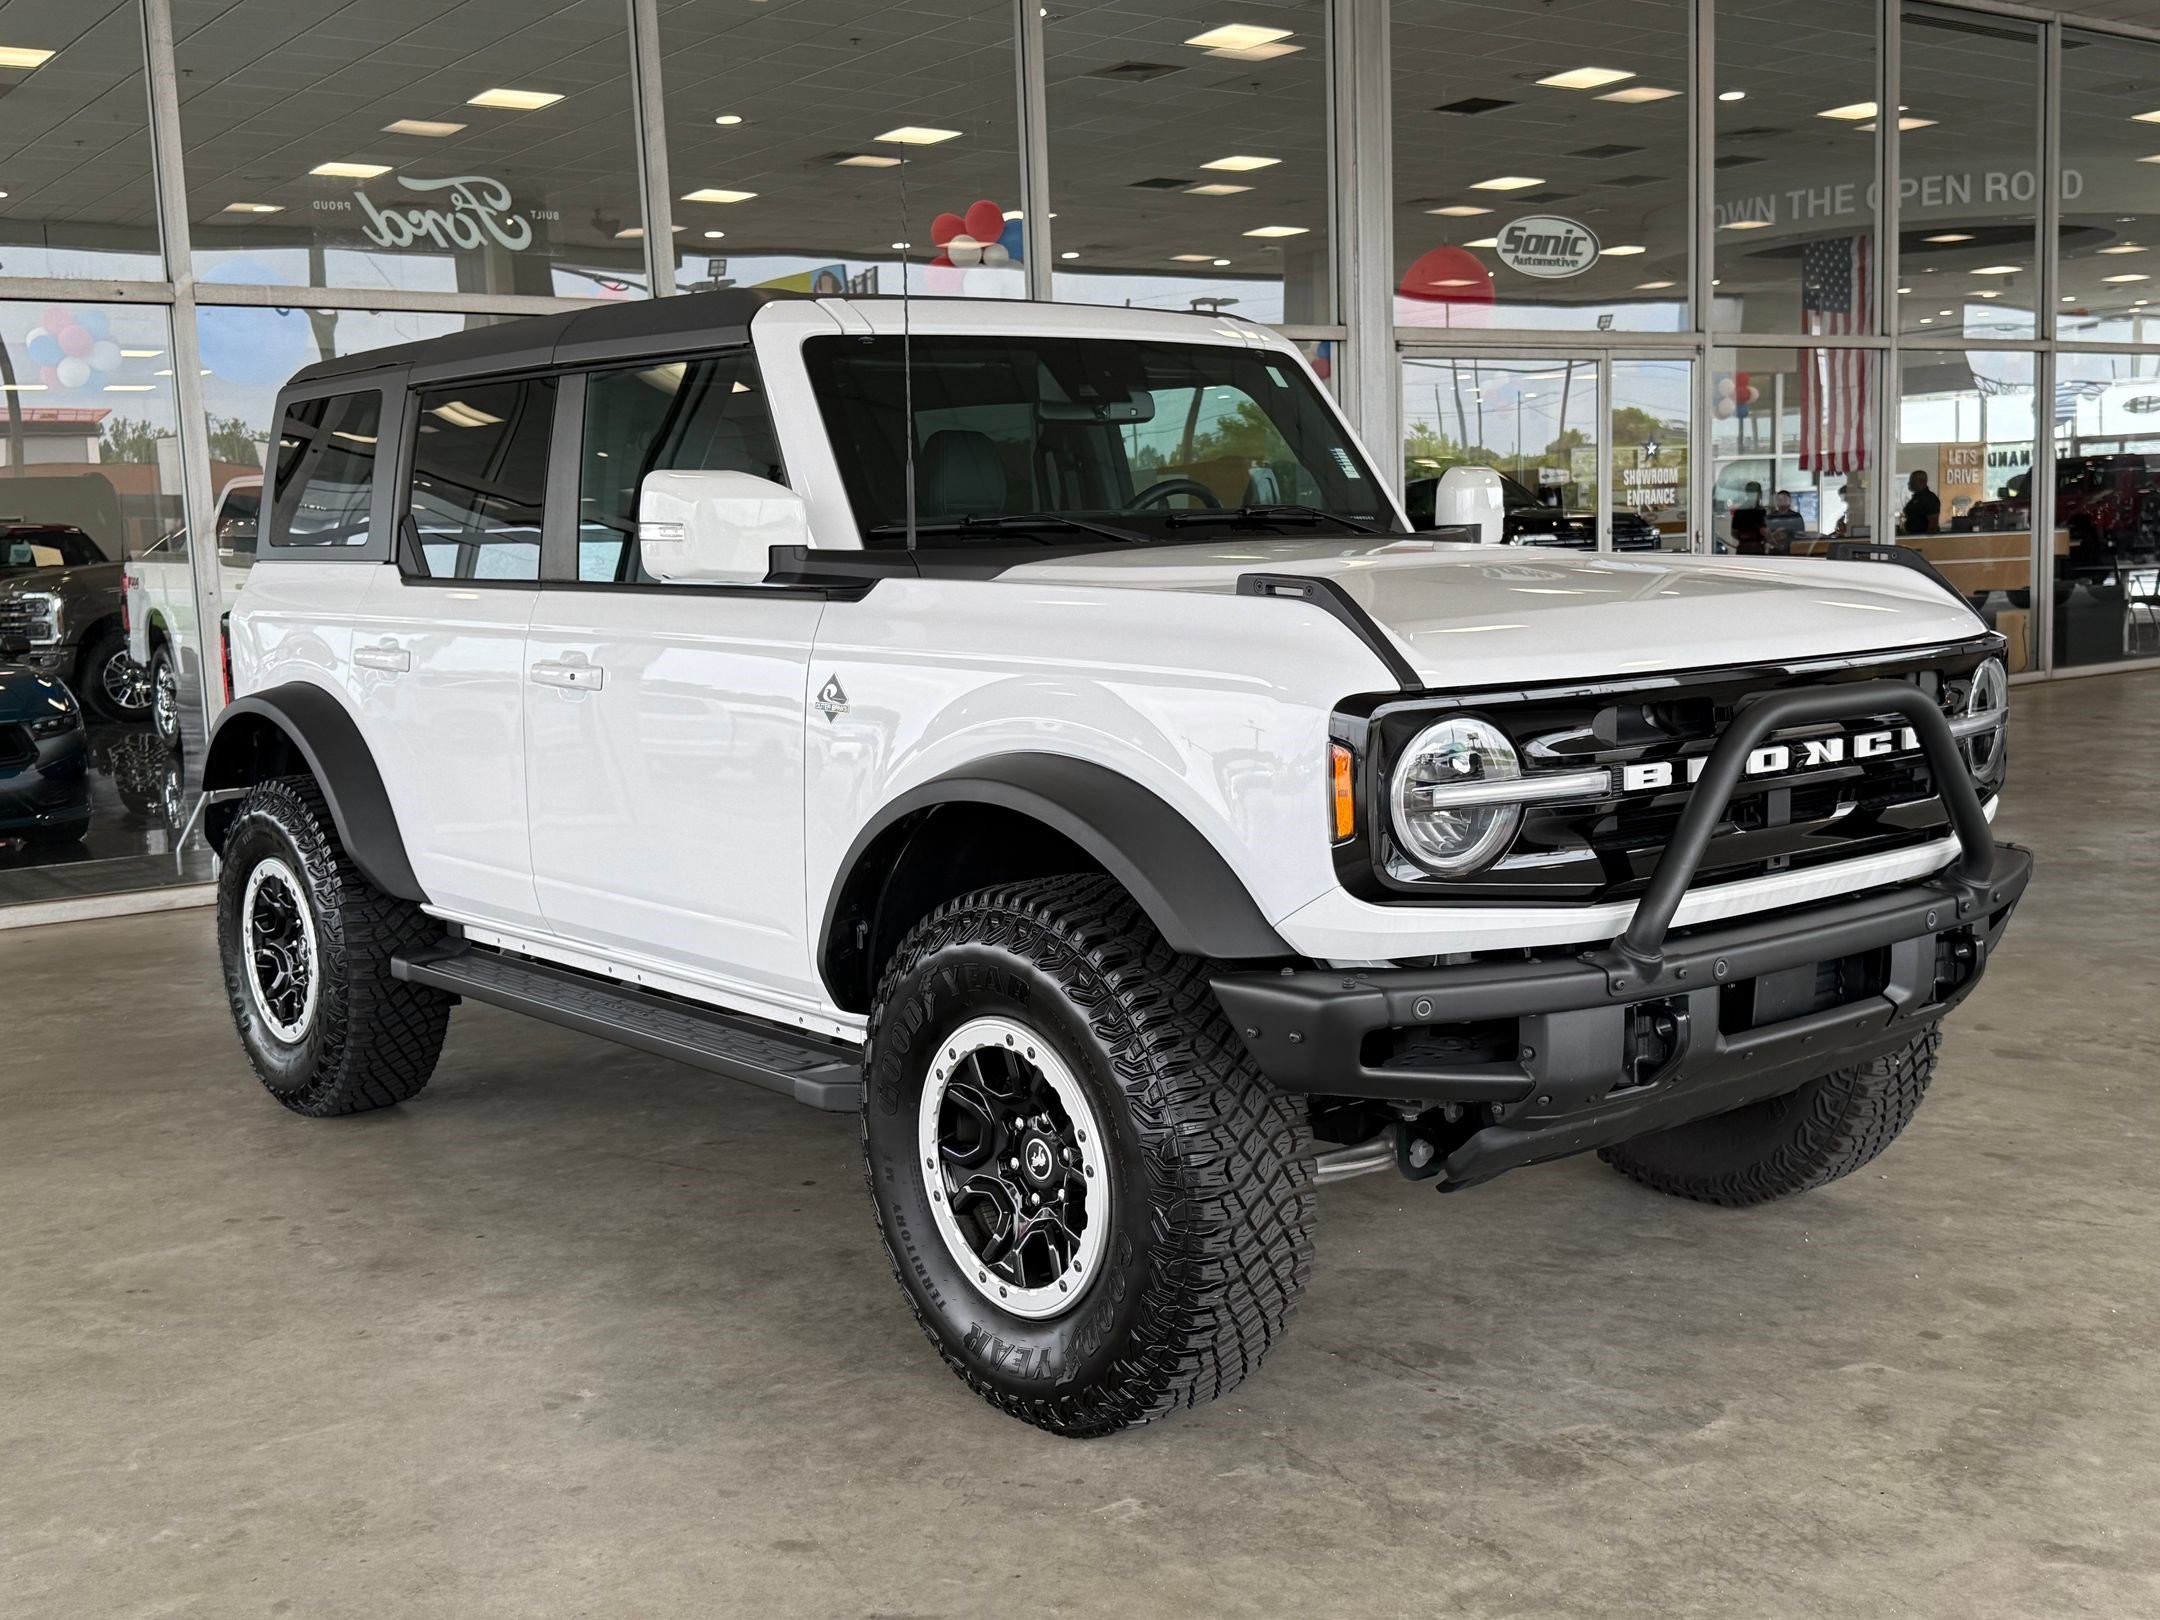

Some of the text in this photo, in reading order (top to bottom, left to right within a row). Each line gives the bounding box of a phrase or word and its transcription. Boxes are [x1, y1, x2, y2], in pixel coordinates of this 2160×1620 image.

[1786, 183, 1855, 220] THE
[1985, 170, 2083, 202] ROD
[1502, 226, 1587, 257] Sonic
[1513, 255, 1579, 268] Automotive
[1948, 448, 1979, 465] LET'S
[1623, 467, 1678, 486] SHOWROOM
[1946, 468, 1979, 484] DRIVE
[1626, 488, 1675, 506] ENTRANCE
